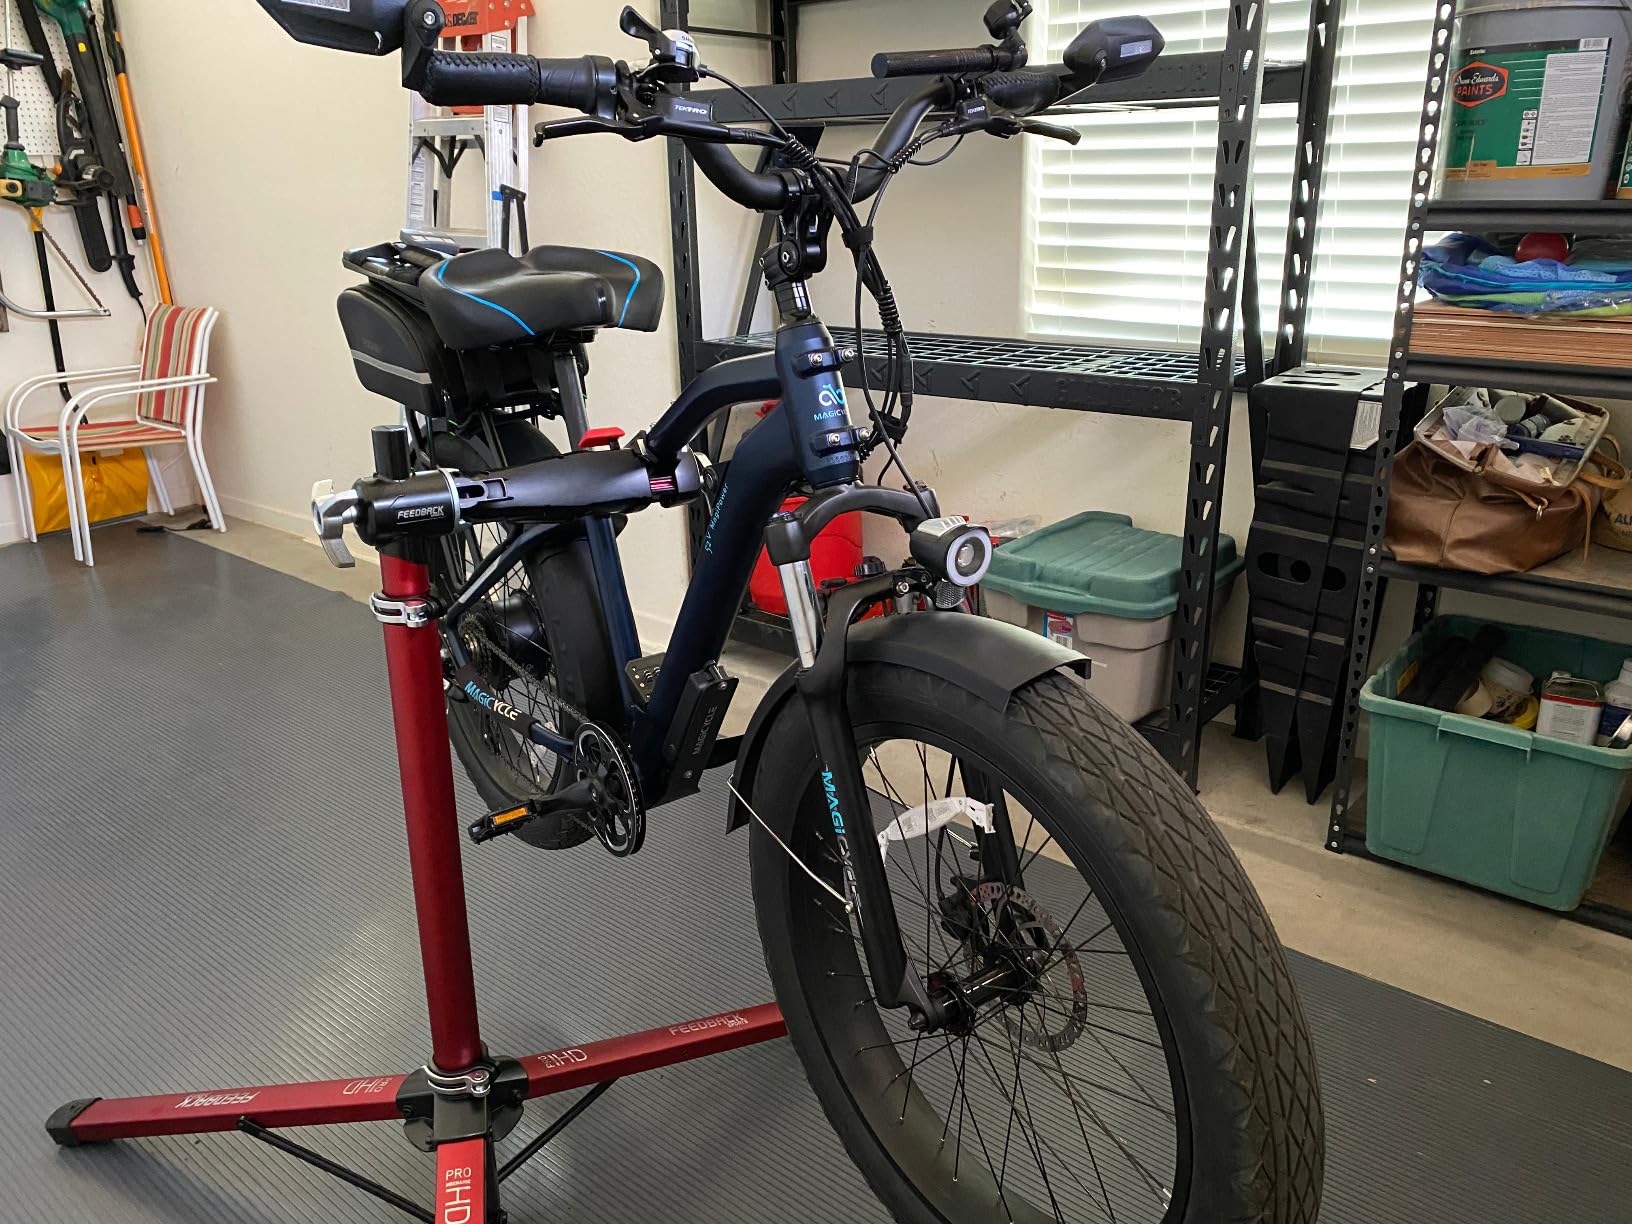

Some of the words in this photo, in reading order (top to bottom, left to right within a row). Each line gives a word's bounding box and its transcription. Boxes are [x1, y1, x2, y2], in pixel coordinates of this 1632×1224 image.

[1457, 83, 1493, 96] PAINTS
[674, 104, 708, 115] TEKTRO
[397, 505, 445, 520] FEEDBACK
[709, 482, 729, 530] MagiPower
[668, 1013, 744, 1036] FEEDBACK
[552, 1049, 588, 1065] HD
[445, 1167, 472, 1181] PRO
[445, 1185, 471, 1224] HD
